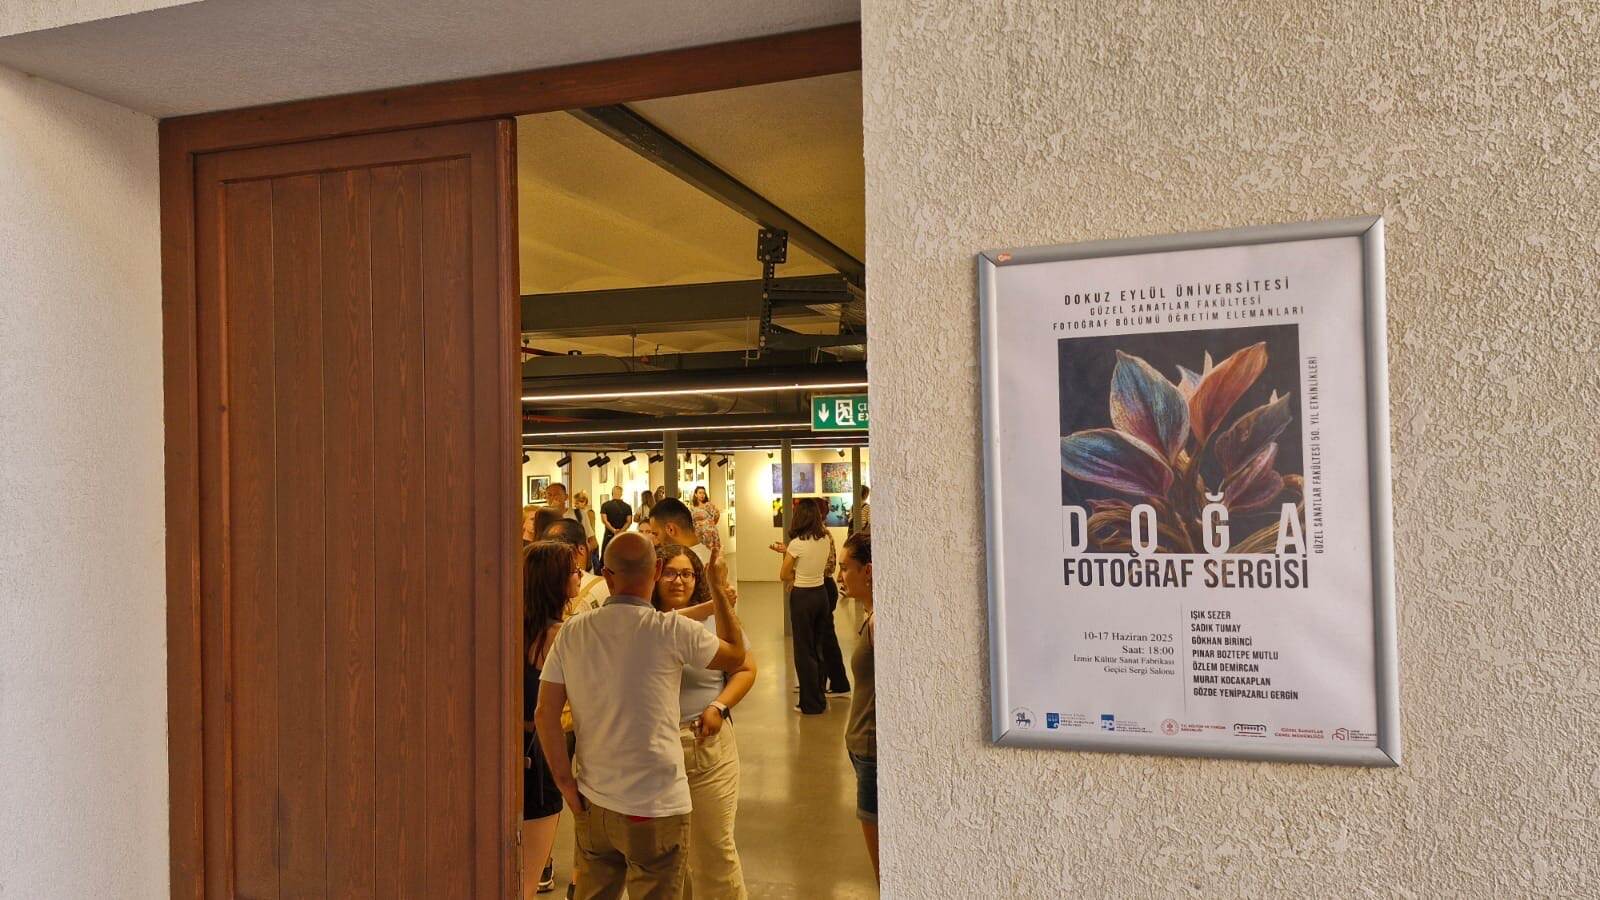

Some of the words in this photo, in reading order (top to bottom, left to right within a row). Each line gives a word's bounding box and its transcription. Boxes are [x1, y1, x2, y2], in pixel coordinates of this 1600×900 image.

[1064, 291, 1110, 305] DOKUZ
[1120, 286, 1165, 301] EYLÜL
[1176, 276, 1289, 297] ÜNİVERSİTESİ
[1090, 305, 1123, 316] GÜZEL
[1131, 301, 1189, 313] SANATLAR
[1197, 295, 1261, 308] FAKÜLTESİ
[1053, 319, 1108, 331] FOTOĞRAF
[1115, 315, 1160, 327] BÖLÜMÜ
[1227, 305, 1304, 320] ELEMANLARI
[1312, 487, 1323, 527] SANATLAR
[1313, 530, 1324, 554] GÜZEL
[1063, 552, 1194, 588] FOTOĞRAF
[1204, 553, 1309, 589] SERGİSİ
[1190, 610, 1205, 620] IŞIK
[1207, 610, 1231, 620] SEZER
[1191, 623, 1213, 632] SADIK
[1215, 623, 1241, 633] TUMAY
[1083, 631, 1109, 641] 10-17
[1112, 632, 1148, 642] Haziran
[1150, 633, 1173, 642] 2025
[1191, 635, 1222, 645] GÖKHAN
[1224, 636, 1252, 646] BİRİNCİ
[1122, 645, 1145, 654] Saat:
[1148, 646, 1174, 655] 18:00
[1192, 649, 1215, 658] PINAR
[1217, 650, 1250, 659] BOZTEPE
[1252, 650, 1279, 660] MUTLU
[1119, 656, 1139, 665] Sanat
[1129, 666, 1148, 676] Sergi
[1192, 661, 1218, 671] ÖZLEM
[1220, 661, 1259, 672] DEMİRCAN
[1193, 675, 1218, 684] MURAT
[1220, 676, 1271, 686] KOCAKAPLAN
[1193, 686, 1217, 697] GÖZDE
[1270, 690, 1299, 700] GERGİN
